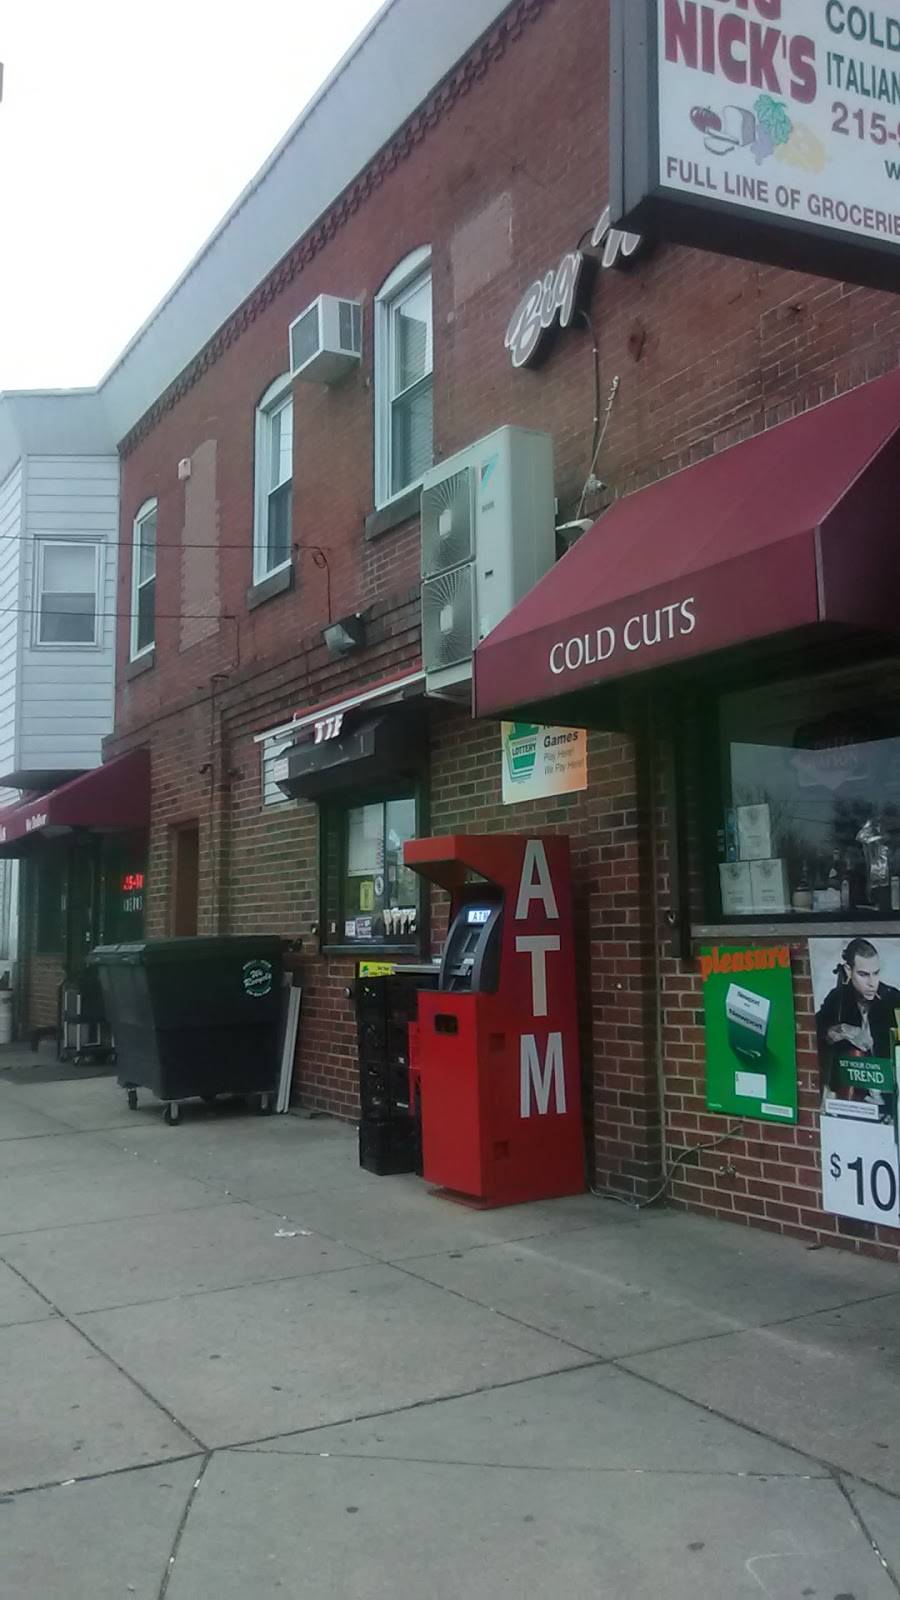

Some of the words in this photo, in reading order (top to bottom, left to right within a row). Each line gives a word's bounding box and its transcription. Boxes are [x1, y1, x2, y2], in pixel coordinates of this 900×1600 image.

[825, 0, 900, 52] COLD
[664, 0, 818, 104] NICK'S
[831, 101, 900, 146] 215-
[666, 156, 717, 190] FULL
[724, 171, 769, 203] LINE
[775, 185, 801, 209] OF
[504, 250, 583, 367] Big
[549, 626, 615, 674] COLD
[623, 597, 696, 650] CUTS
[511, 743, 536, 756] LOTTERY
[543, 731, 578, 748] Games
[515, 839, 567, 1119] ATM
[700, 946, 790, 981] pleasure
[737, 991, 761, 1006] Newport
[728, 1008, 763, 1030] Newport
[839, 1059, 848, 1067] SET
[849, 1061, 864, 1069] YOUR
[847, 1069, 884, 1083] TREND
